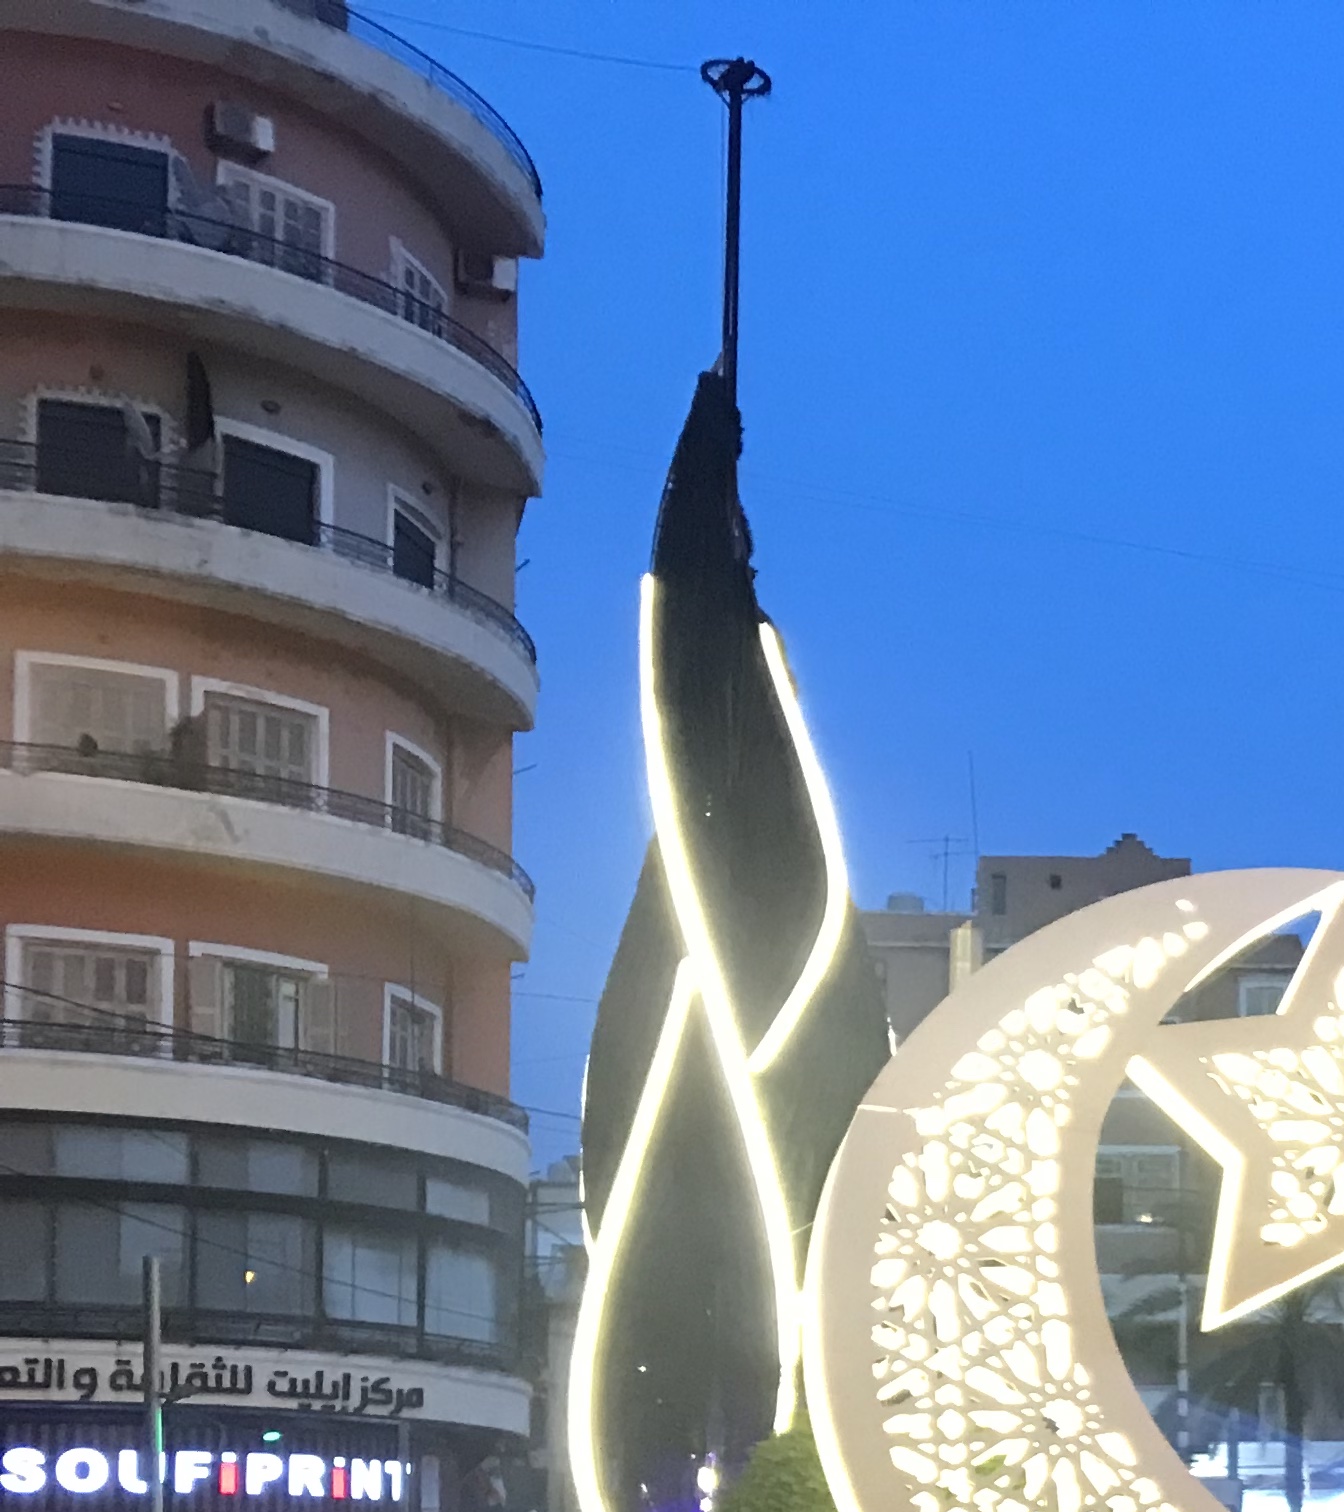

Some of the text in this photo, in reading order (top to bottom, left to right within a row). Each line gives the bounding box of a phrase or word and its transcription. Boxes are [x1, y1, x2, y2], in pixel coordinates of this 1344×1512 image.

[108, 1355, 253, 1395] للثقاة
[266, 1369, 352, 1412] ايليت
[352, 1375, 425, 1417] مركز
